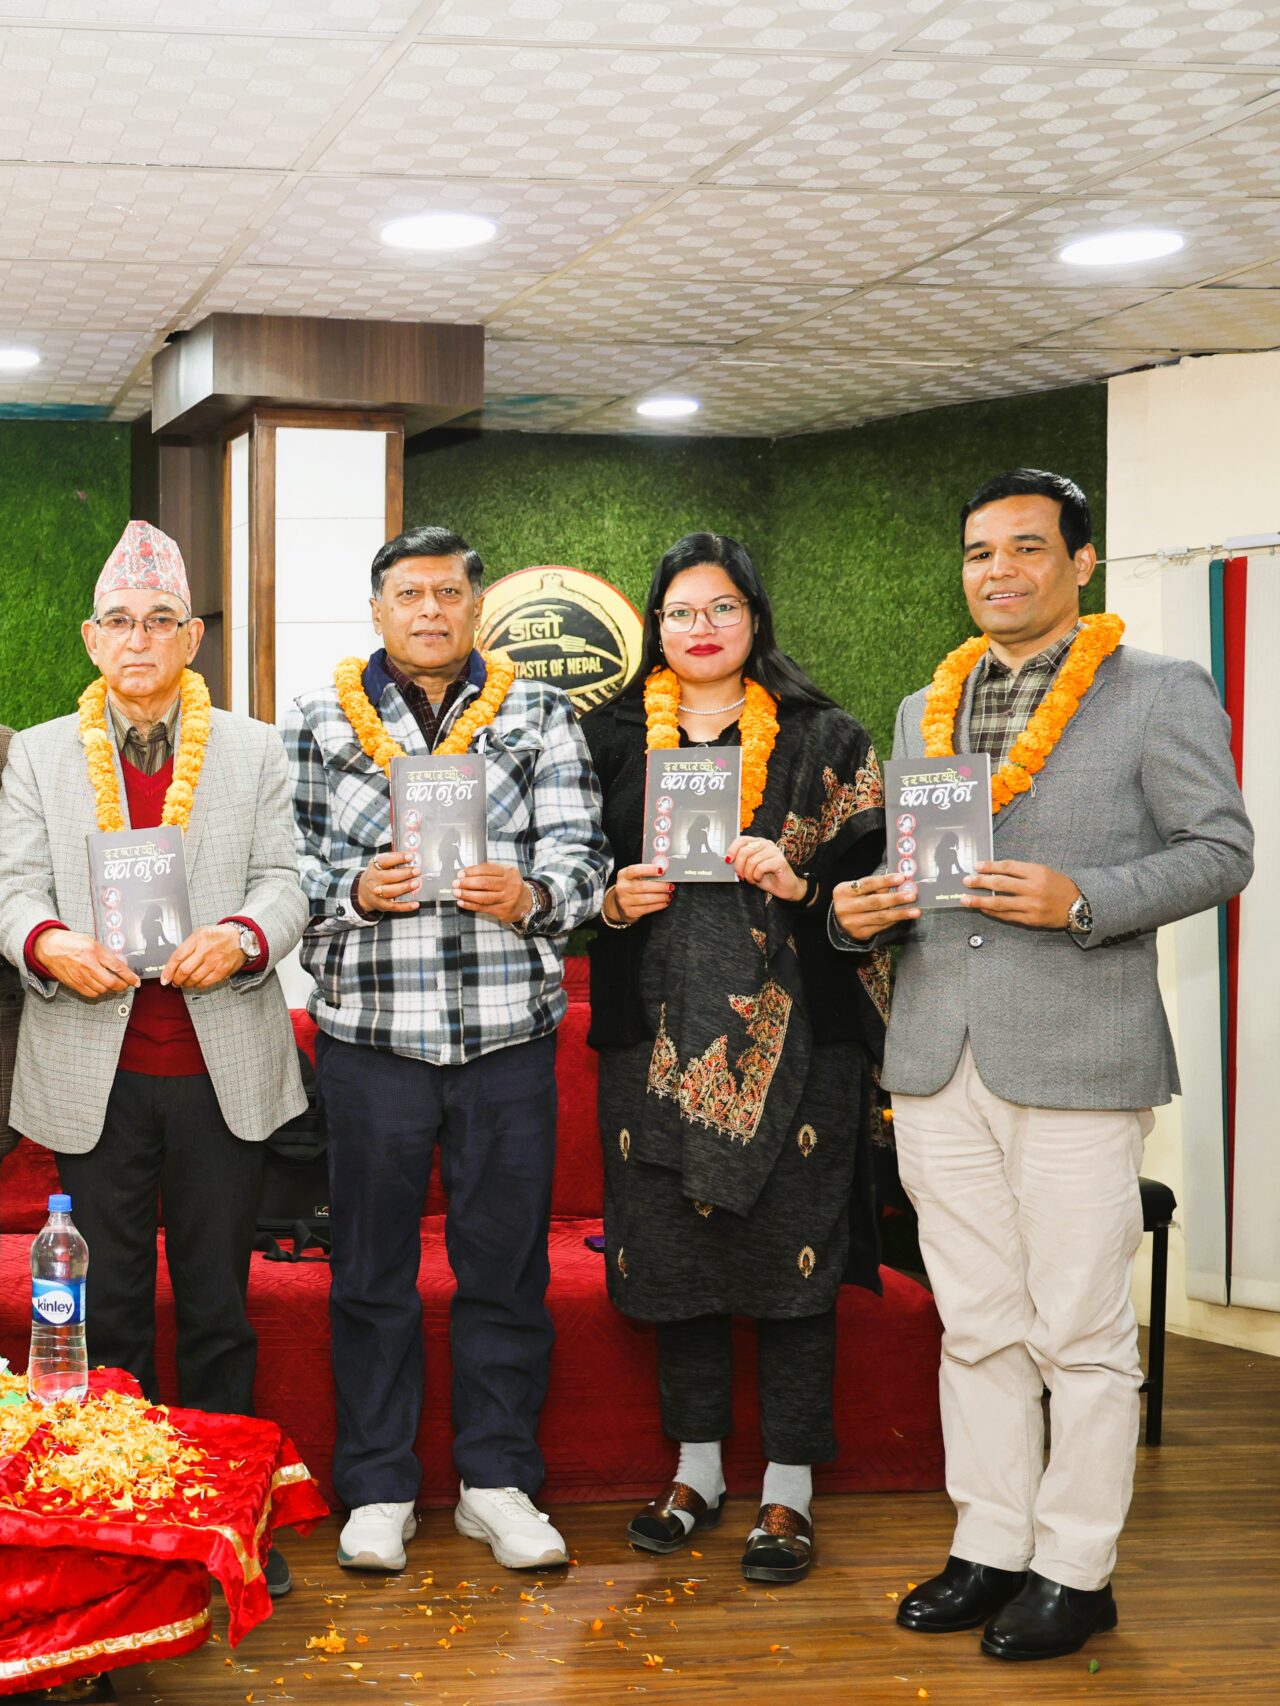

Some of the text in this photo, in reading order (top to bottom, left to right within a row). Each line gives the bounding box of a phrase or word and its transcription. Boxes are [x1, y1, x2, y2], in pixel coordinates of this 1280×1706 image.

[514, 656, 604, 678] TASTE OF NEPAL
[406, 779, 479, 807] कानुन
[660, 771, 732, 796] कानुन
[899, 781, 978, 810] कानुन
[104, 853, 176, 883] कानुन
[37, 1298, 72, 1314] kinley
